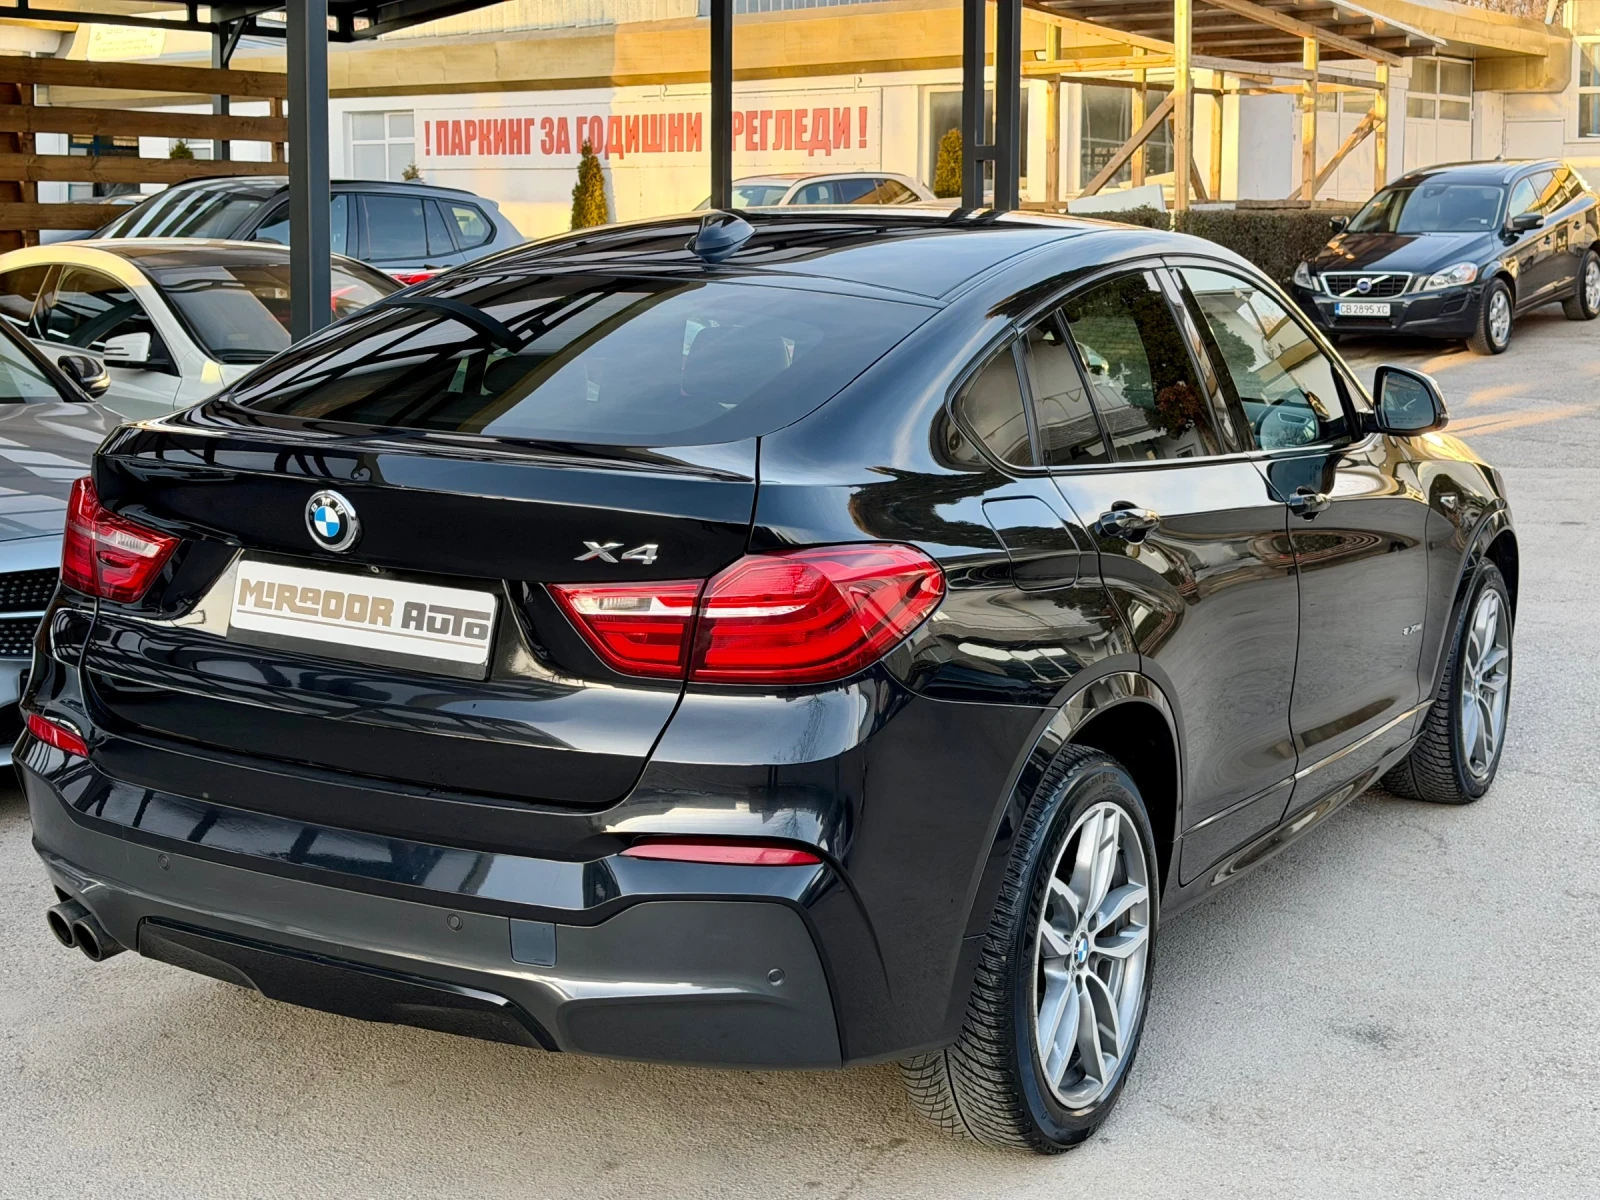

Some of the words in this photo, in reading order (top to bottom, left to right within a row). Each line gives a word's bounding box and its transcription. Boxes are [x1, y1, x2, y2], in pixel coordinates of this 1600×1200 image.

[436, 118, 535, 156] ПАРКИНГ
[540, 116, 571, 155] ЗА
[576, 112, 702, 160] ГОДИШНИ
[732, 107, 851, 156] РЕГЛЕДИ
[1340, 304, 1352, 314] CB
[1353, 304, 1375, 314] 2895
[1376, 305, 1388, 314] XC
[311, 497, 346, 515] BMW
[573, 541, 659, 565] X4
